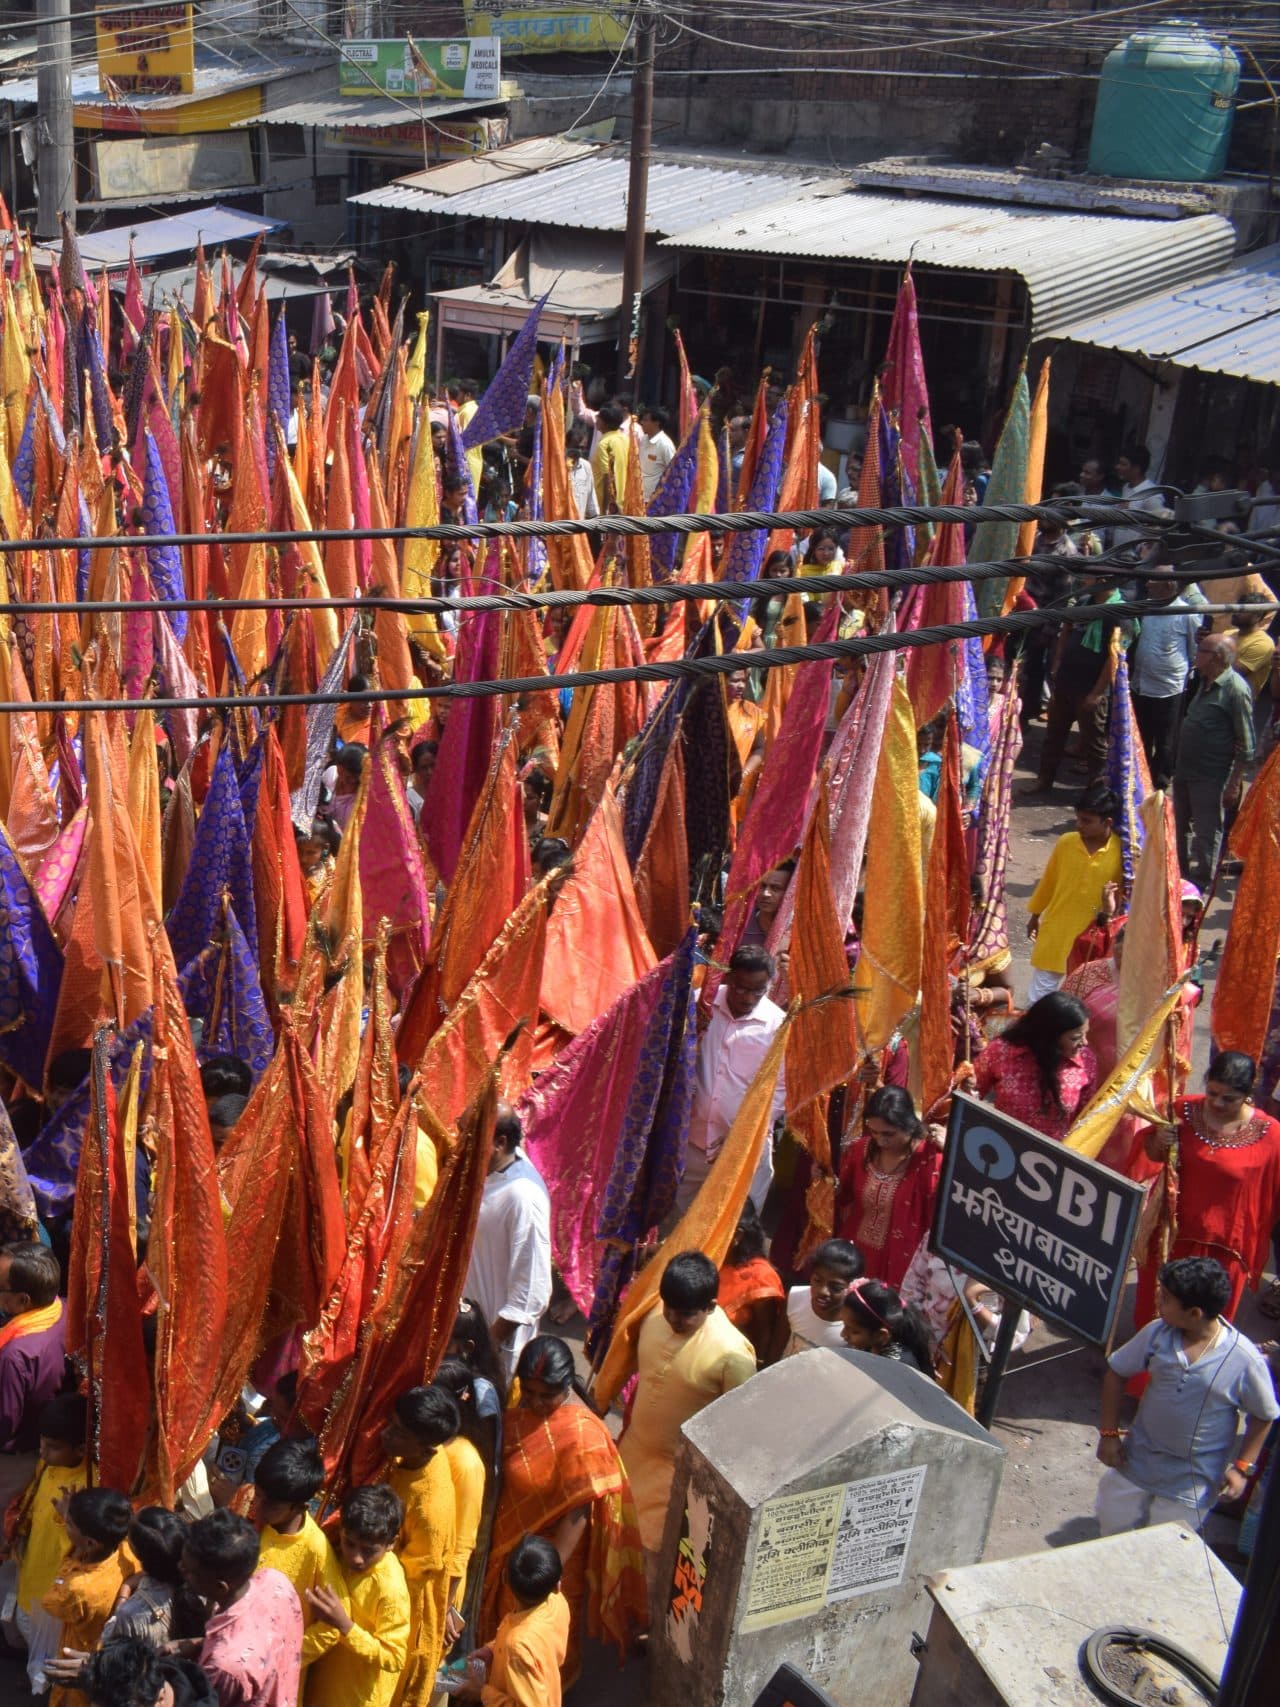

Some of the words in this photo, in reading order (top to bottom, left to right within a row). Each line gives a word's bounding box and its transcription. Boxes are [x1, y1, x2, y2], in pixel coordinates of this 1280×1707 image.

[471, 61, 498, 69] MEDICALS
[473, 49, 495, 57] AMULYA
[1016, 1150, 1122, 1245] SBI
[1034, 1225, 1113, 1301] बाजार
[992, 1248, 1077, 1310] शाखा
[838, 1528, 860, 1543] भूमि
[864, 1519, 909, 1535] क्लीनिक
[757, 1549, 780, 1564] भूमि
[784, 1538, 830, 1555] क्लीनिक
